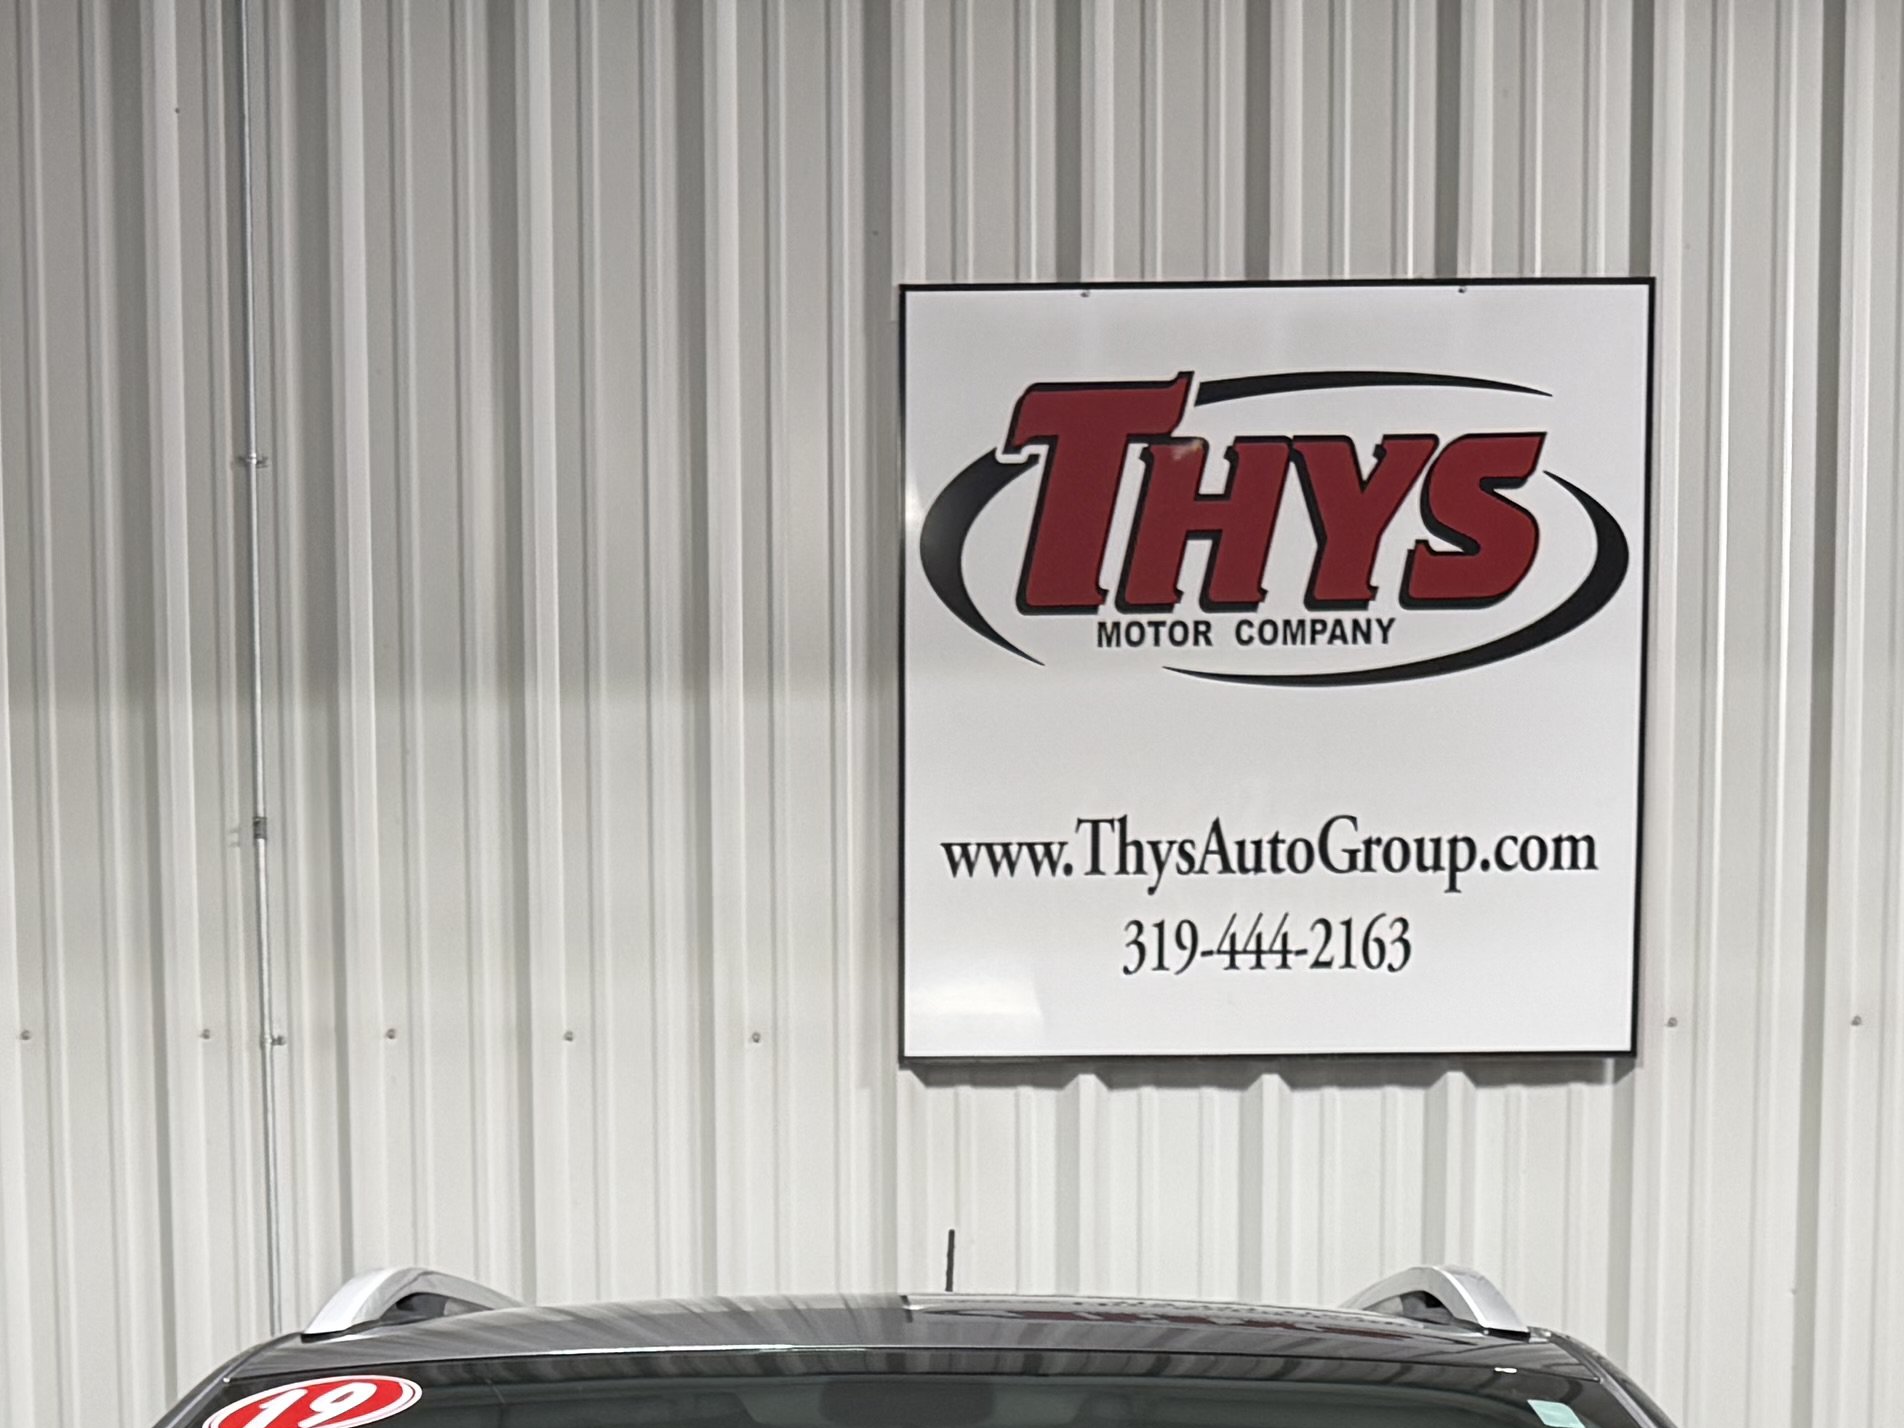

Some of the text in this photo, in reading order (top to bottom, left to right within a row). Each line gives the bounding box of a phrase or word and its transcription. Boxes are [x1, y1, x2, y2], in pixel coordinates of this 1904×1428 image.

[1000, 371, 1547, 614] THYS
[1096, 617, 1396, 648] MOTOR COMPANY
[941, 814, 1599, 895] www.ThysAutoGroup.com
[1122, 912, 1412, 976] 319-444-2163
